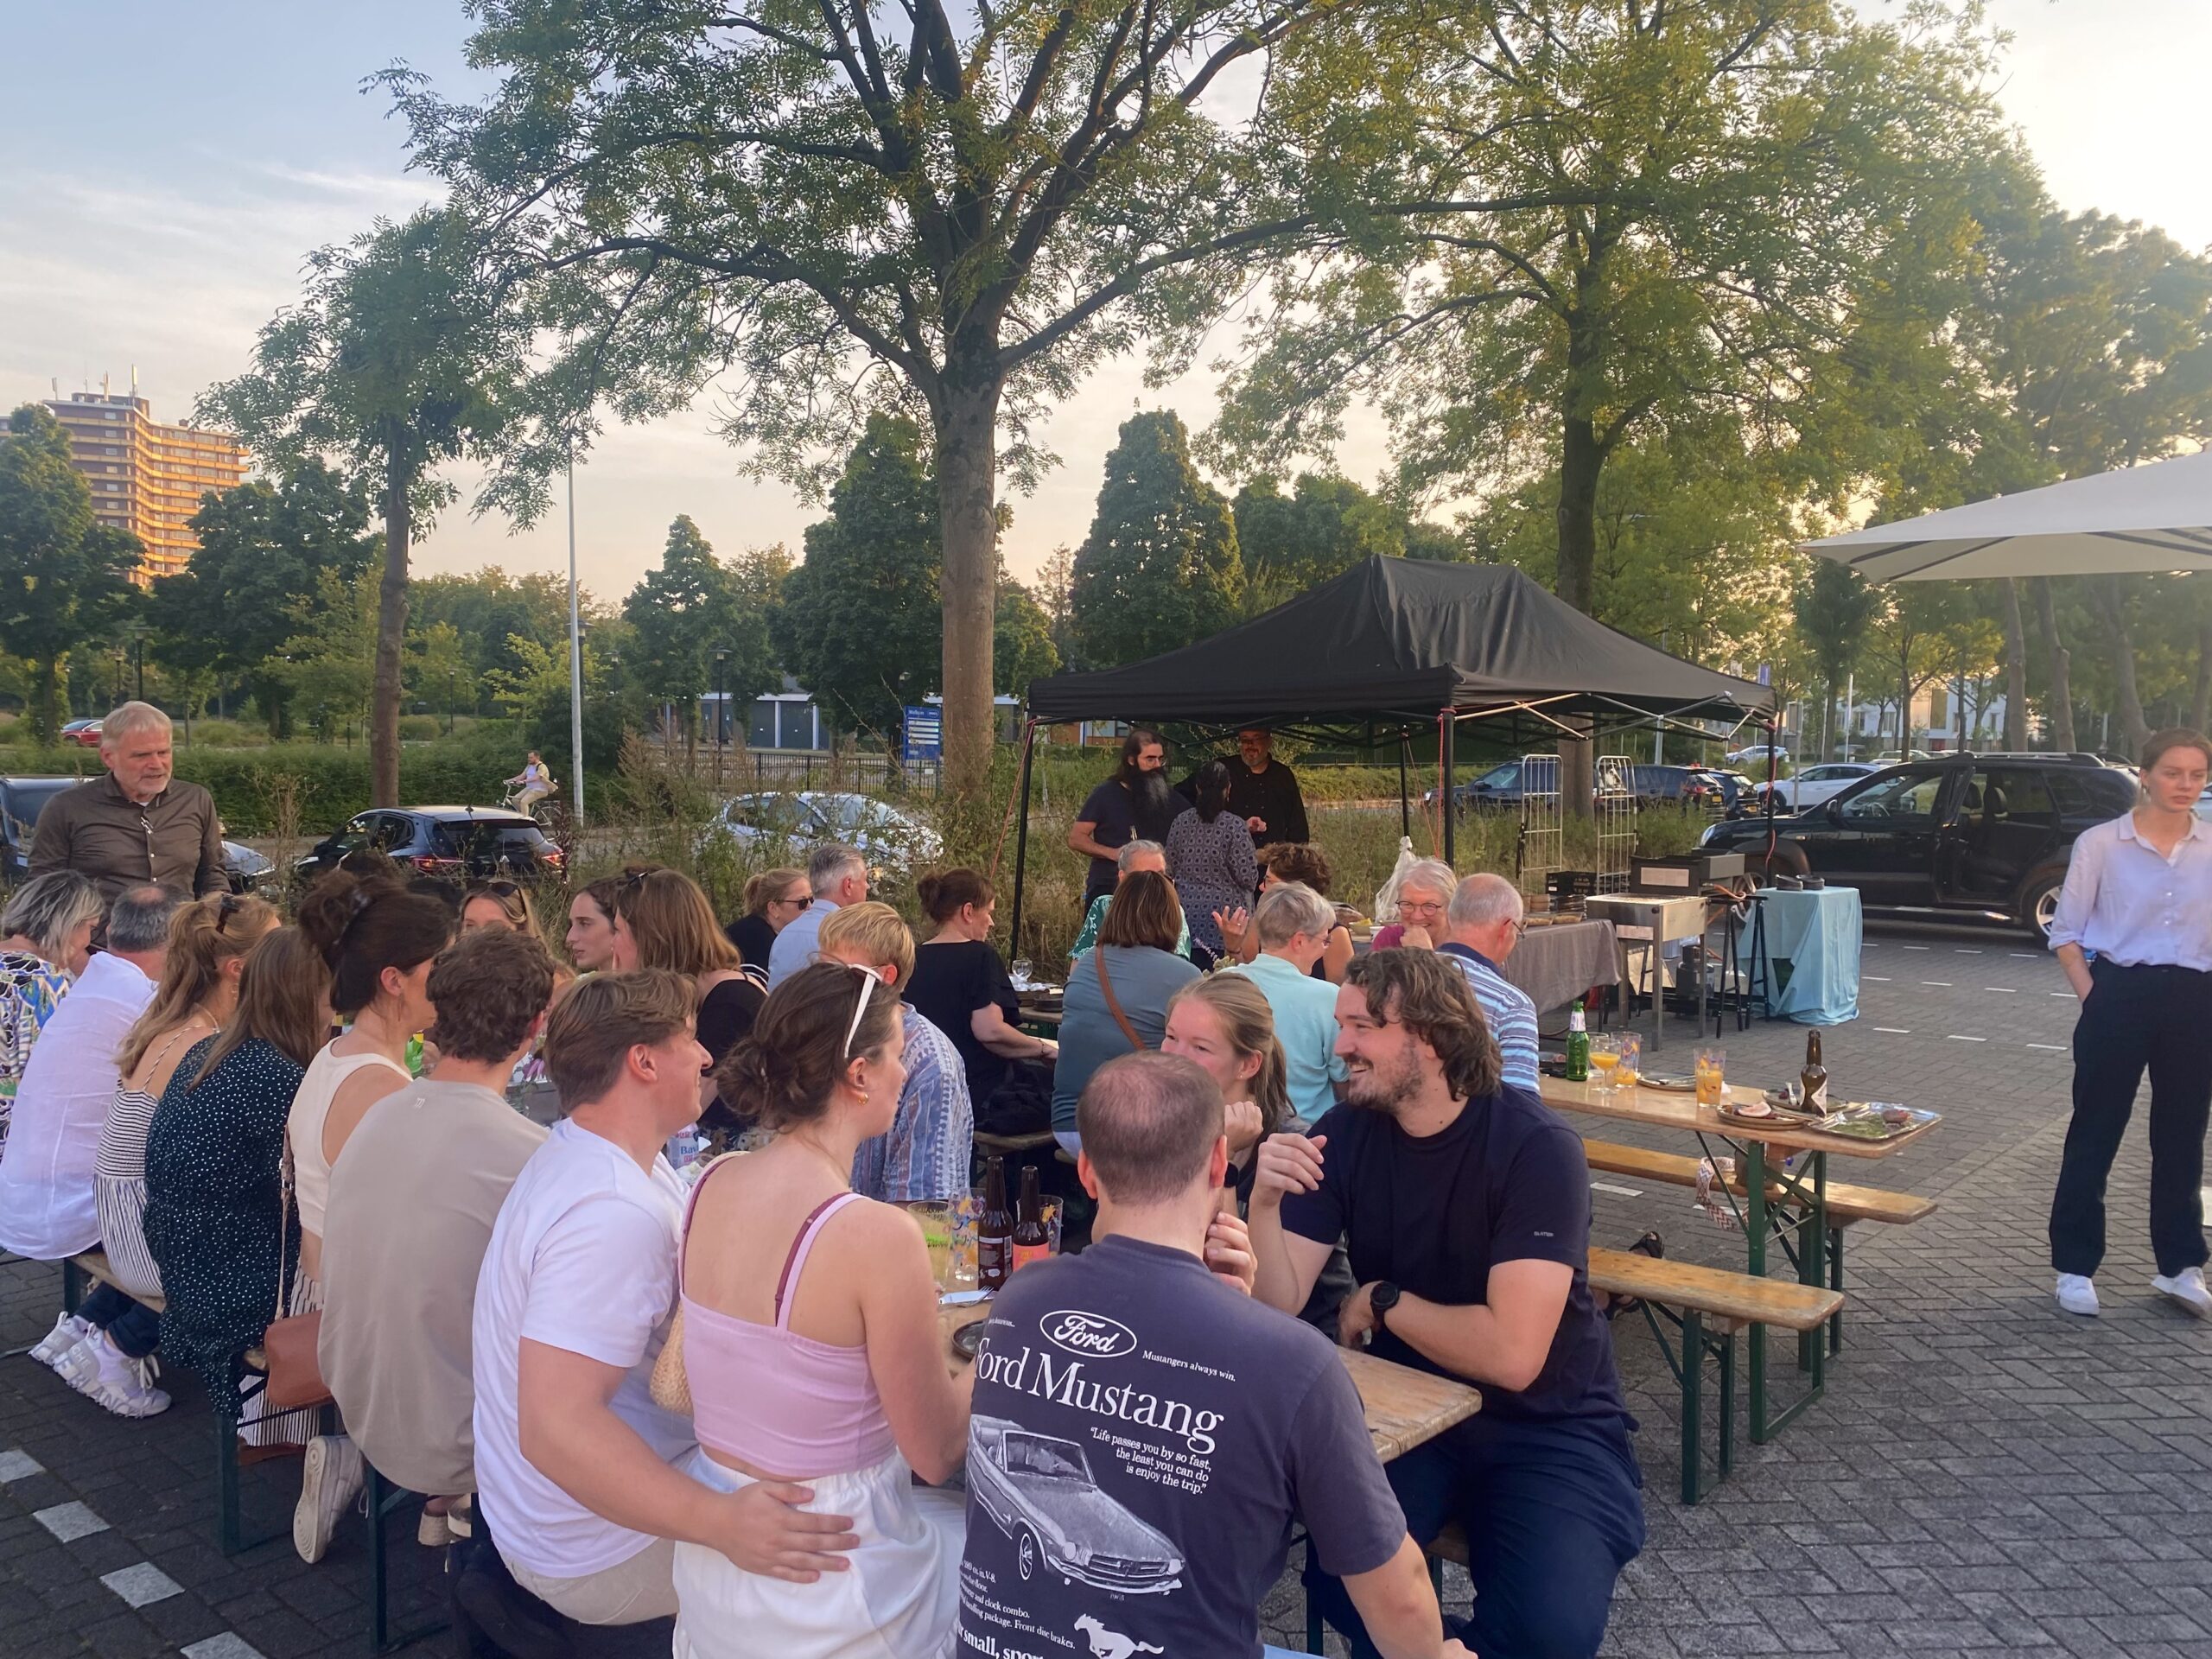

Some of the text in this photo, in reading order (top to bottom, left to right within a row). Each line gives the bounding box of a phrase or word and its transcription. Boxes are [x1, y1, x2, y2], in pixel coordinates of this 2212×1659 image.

[1053, 1314, 1121, 1352] Ford
[1141, 1350, 1236, 1382] Mustangers always win.
[1027, 1352, 1224, 1455] Mustang
[1111, 1435, 1141, 1450] passes
[1141, 1443, 1160, 1455] you
[1160, 1446, 1175, 1461] by
[1175, 1452, 1187, 1463] so
[1189, 1454, 1211, 1473] fast,
[1116, 1446, 1209, 1483] the least you can do
[1126, 1462, 1135, 1474] is
[1135, 1467, 1161, 1483] enjoy
[1162, 1472, 1179, 1488] the
[984, 1597, 1002, 1611] clock
[1002, 1605, 1031, 1619] combo.
[963, 1629, 1000, 1659] small,
[983, 1611, 1013, 1628] package.
[1014, 1618, 1036, 1633] Front
[1036, 1624, 1052, 1639] disc
[1050, 1630, 1077, 1650] brakes.
